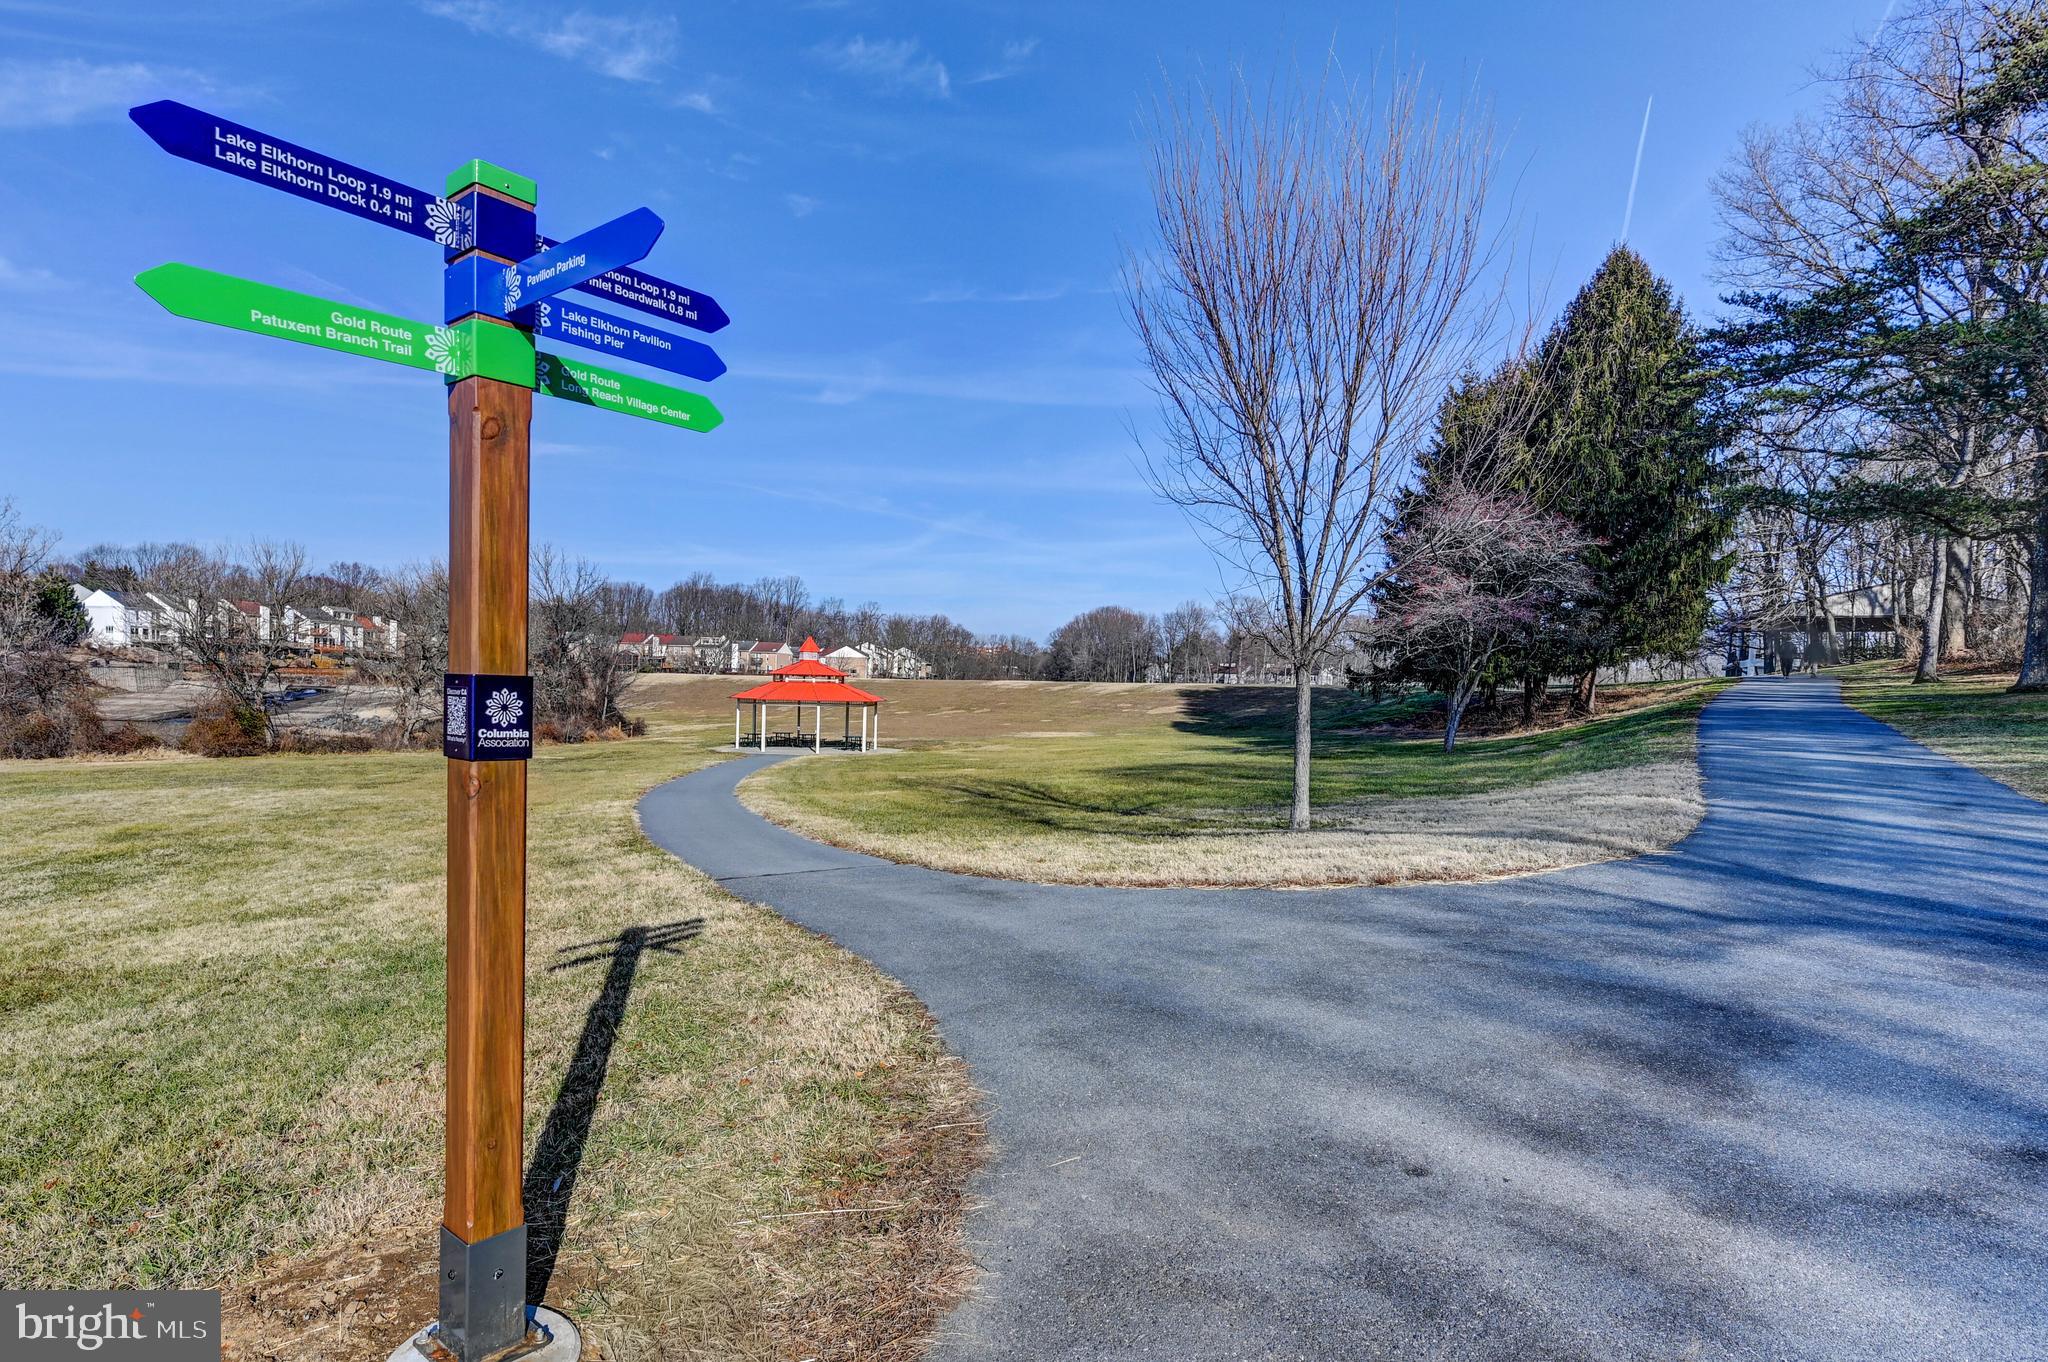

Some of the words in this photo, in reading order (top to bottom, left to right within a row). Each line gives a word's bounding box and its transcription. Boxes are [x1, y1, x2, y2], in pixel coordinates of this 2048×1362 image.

[215, 127, 257, 153] Lake
[261, 143, 323, 177] Elkhorn
[328, 167, 367, 193] Loop
[370, 184, 391, 201] 1.9
[395, 193, 413, 208] mi
[215, 145, 257, 170] Lake
[261, 161, 323, 193] Elkhorn
[328, 185, 367, 208] Dock
[370, 199, 391, 217] 0.4
[395, 210, 413, 224] mi
[527, 266, 555, 287] Pavilion
[557, 254, 586, 273] Parking
[615, 284, 667, 311] Boardwalk
[669, 303, 683, 316] 0.8
[686, 310, 698, 321] mi
[634, 278, 659, 296] Loop
[662, 288, 676, 301] 1.9
[678, 294, 690, 305] mi
[251, 309, 321, 337] Patuxent
[326, 326, 378, 349] Branch
[382, 340, 412, 356] Trail
[331, 312, 366, 330] Gold
[371, 321, 413, 341] Route
[562, 308, 588, 325] Lake
[591, 317, 630, 338] Elkhorn
[633, 331, 671, 350] Pavilion
[562, 322, 601, 345] Fishing
[604, 336, 625, 350] Pier
[562, 366, 587, 382] Gold
[591, 374, 621, 390] Route
[562, 380, 589, 398] Long
[592, 388, 623, 404] Reach
[626, 397, 659, 414] Village
[661, 406, 691, 422] Center
[478, 729, 529, 738] Columbia
[478, 738, 529, 747] Association
